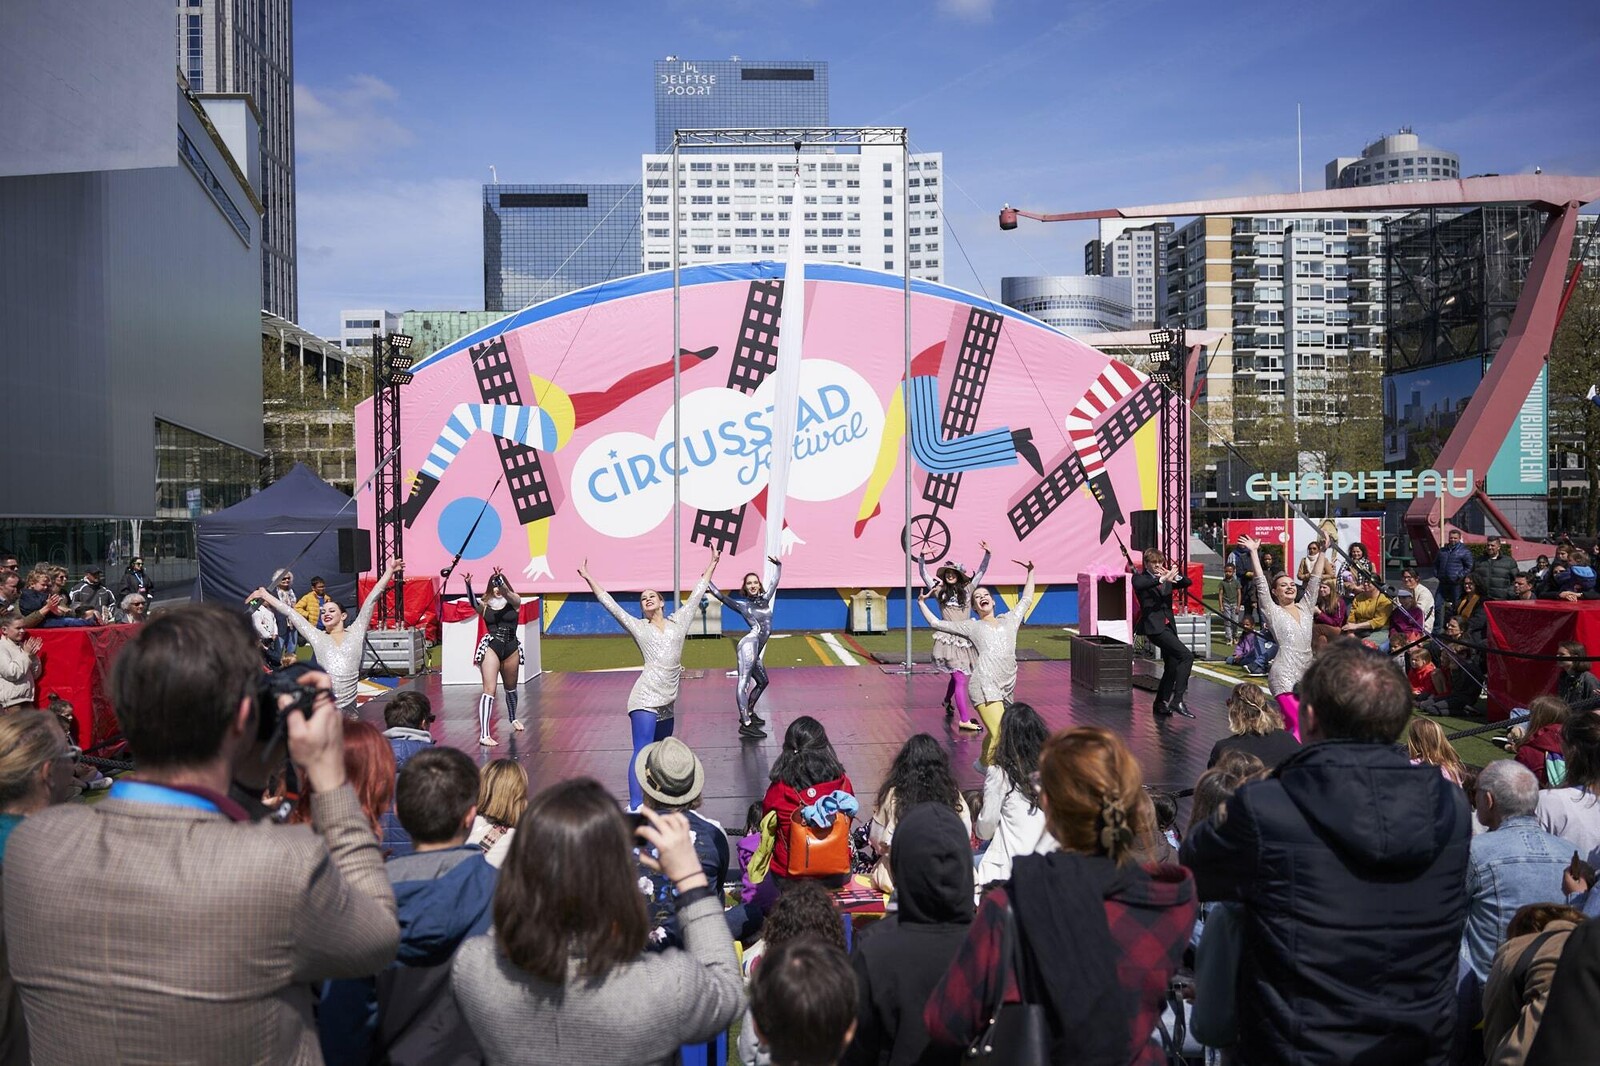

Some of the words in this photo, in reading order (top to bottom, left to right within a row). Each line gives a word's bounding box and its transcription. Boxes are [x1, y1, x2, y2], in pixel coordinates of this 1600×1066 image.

[661, 74, 716, 84] DELFTSE
[667, 85, 711, 95] POORT
[588, 384, 850, 503] CIRCUSSAD
[1245, 469, 1473, 501] CHAPITEAU
